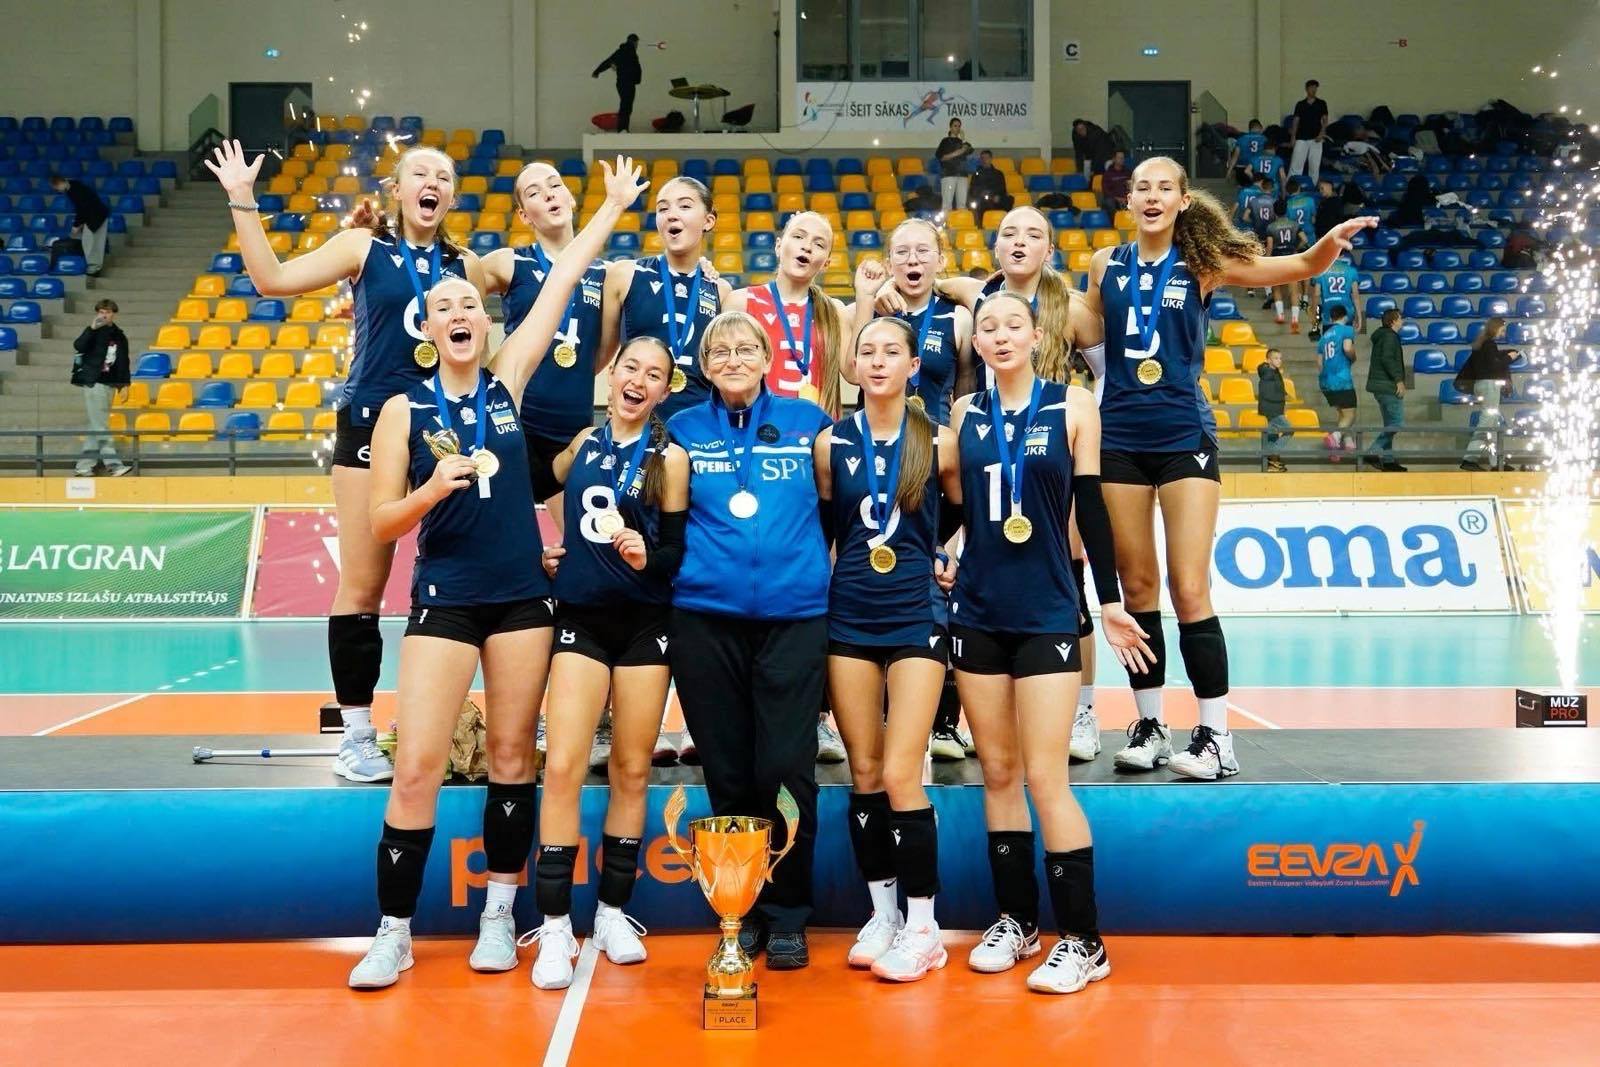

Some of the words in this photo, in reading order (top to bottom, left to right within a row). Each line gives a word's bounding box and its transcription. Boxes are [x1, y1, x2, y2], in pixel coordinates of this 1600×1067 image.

[1065, 43, 1078, 57] C
[850, 102, 871, 117] ŠEIT
[875, 101, 909, 117] SĀKAS
[946, 103, 977, 117] TAVAS
[980, 103, 1027, 116] UZVARAS
[1250, 141, 1258, 153] 3
[1260, 159, 1271, 173] 15
[1260, 207, 1269, 220] 13
[1296, 209, 1304, 224] 2
[1280, 229, 1291, 243] 14
[1328, 276, 1346, 293] 22
[583, 295, 600, 309] UKR
[1161, 299, 1185, 310] UKR
[699, 306, 717, 319] UKR
[1124, 306, 1161, 360] 5
[1324, 341, 1336, 360] 16
[778, 340, 814, 392] 3
[495, 423, 519, 435] UKR
[580, 485, 624, 544] 8
[7, 544, 167, 571] LATGRAN
[1209, 525, 1477, 589] oma
[66, 589, 121, 603] IZLAŠU
[126, 590, 229, 605] ATBALSTĪTĀJS
[951, 636, 963, 657] 11
[1550, 696, 1579, 708] MUZ
[1550, 708, 1579, 720] PRO
[1247, 843, 1389, 877] EEVZA
[719, 1016, 746, 1024] PLACE
